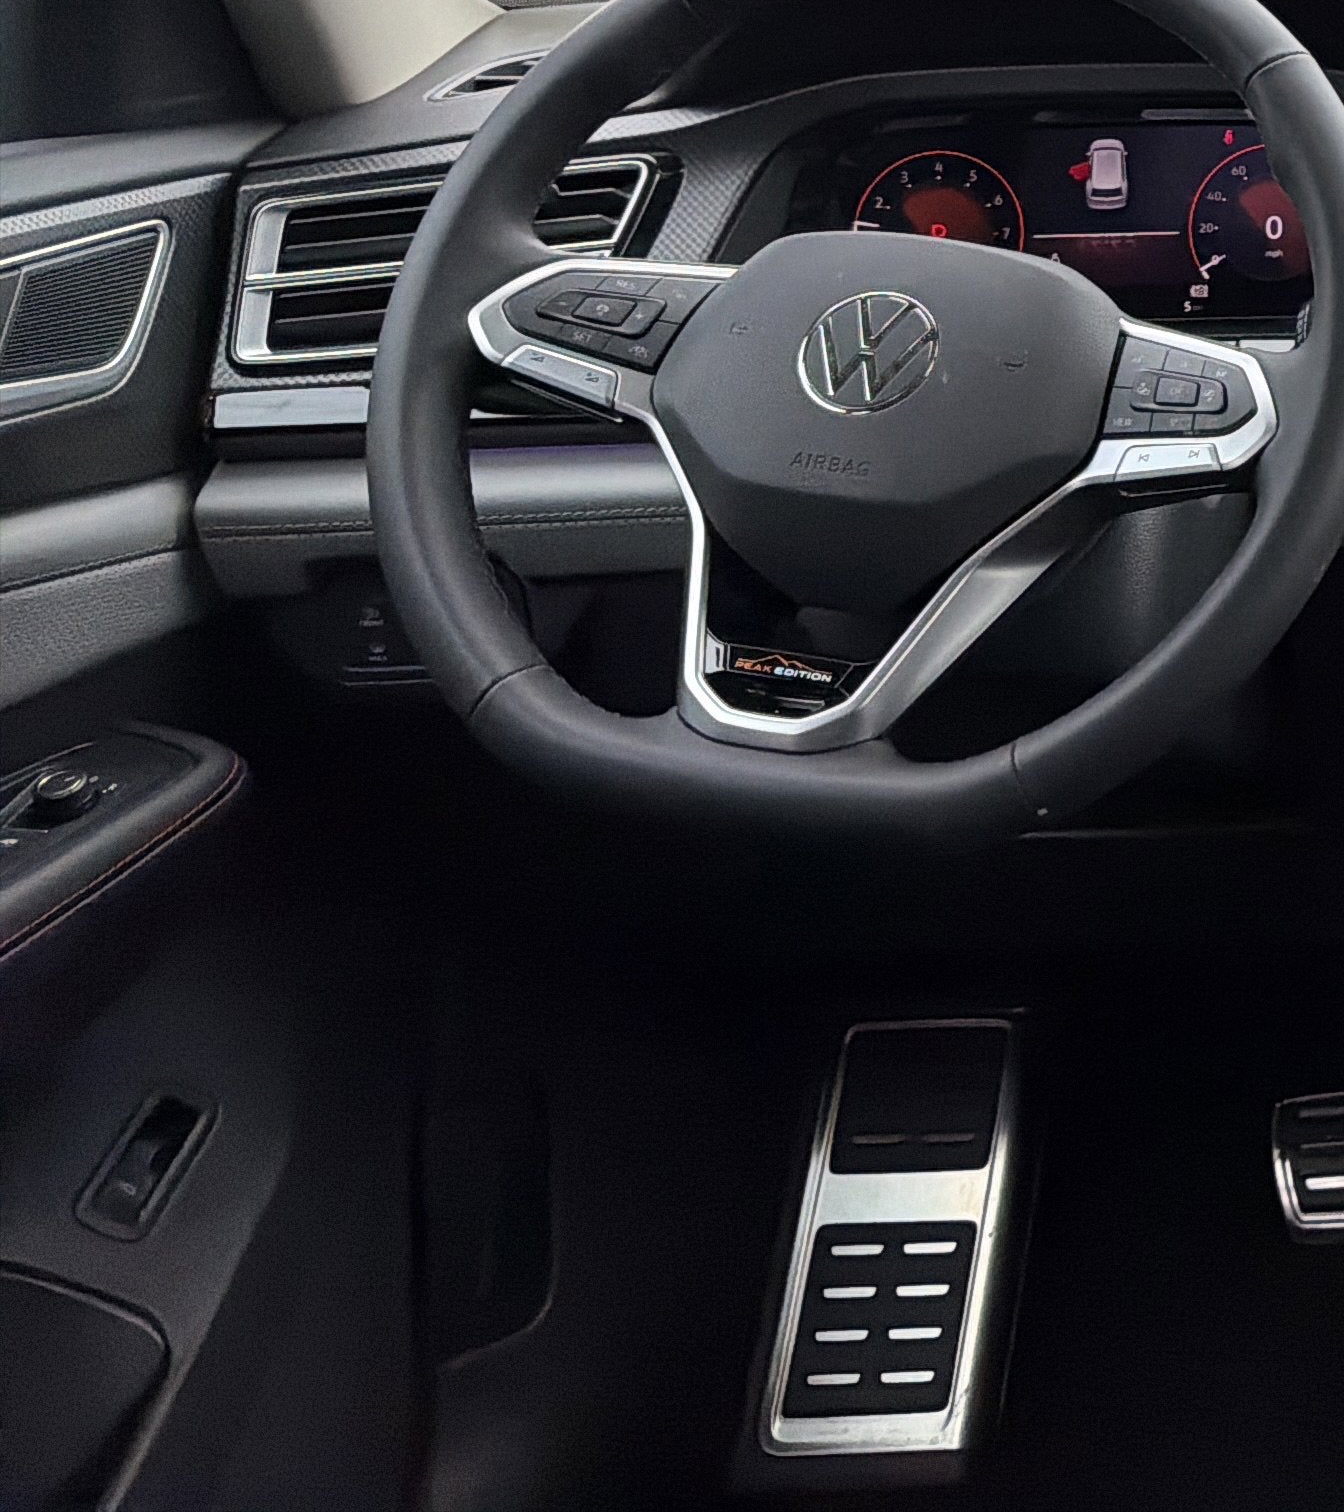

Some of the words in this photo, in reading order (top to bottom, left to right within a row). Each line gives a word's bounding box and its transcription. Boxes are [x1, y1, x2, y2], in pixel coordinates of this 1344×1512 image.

[934, 161, 944, 173] 4
[1231, 165, 1247, 176] 60
[969, 170, 978, 182] 5
[874, 196, 884, 209] 2
[994, 194, 1004, 206] 6
[1199, 223, 1214, 234] 20
[1265, 215, 1283, 240] 0
[789, 451, 872, 477] AIRBAG
[773, 666, 833, 683] EDITION
